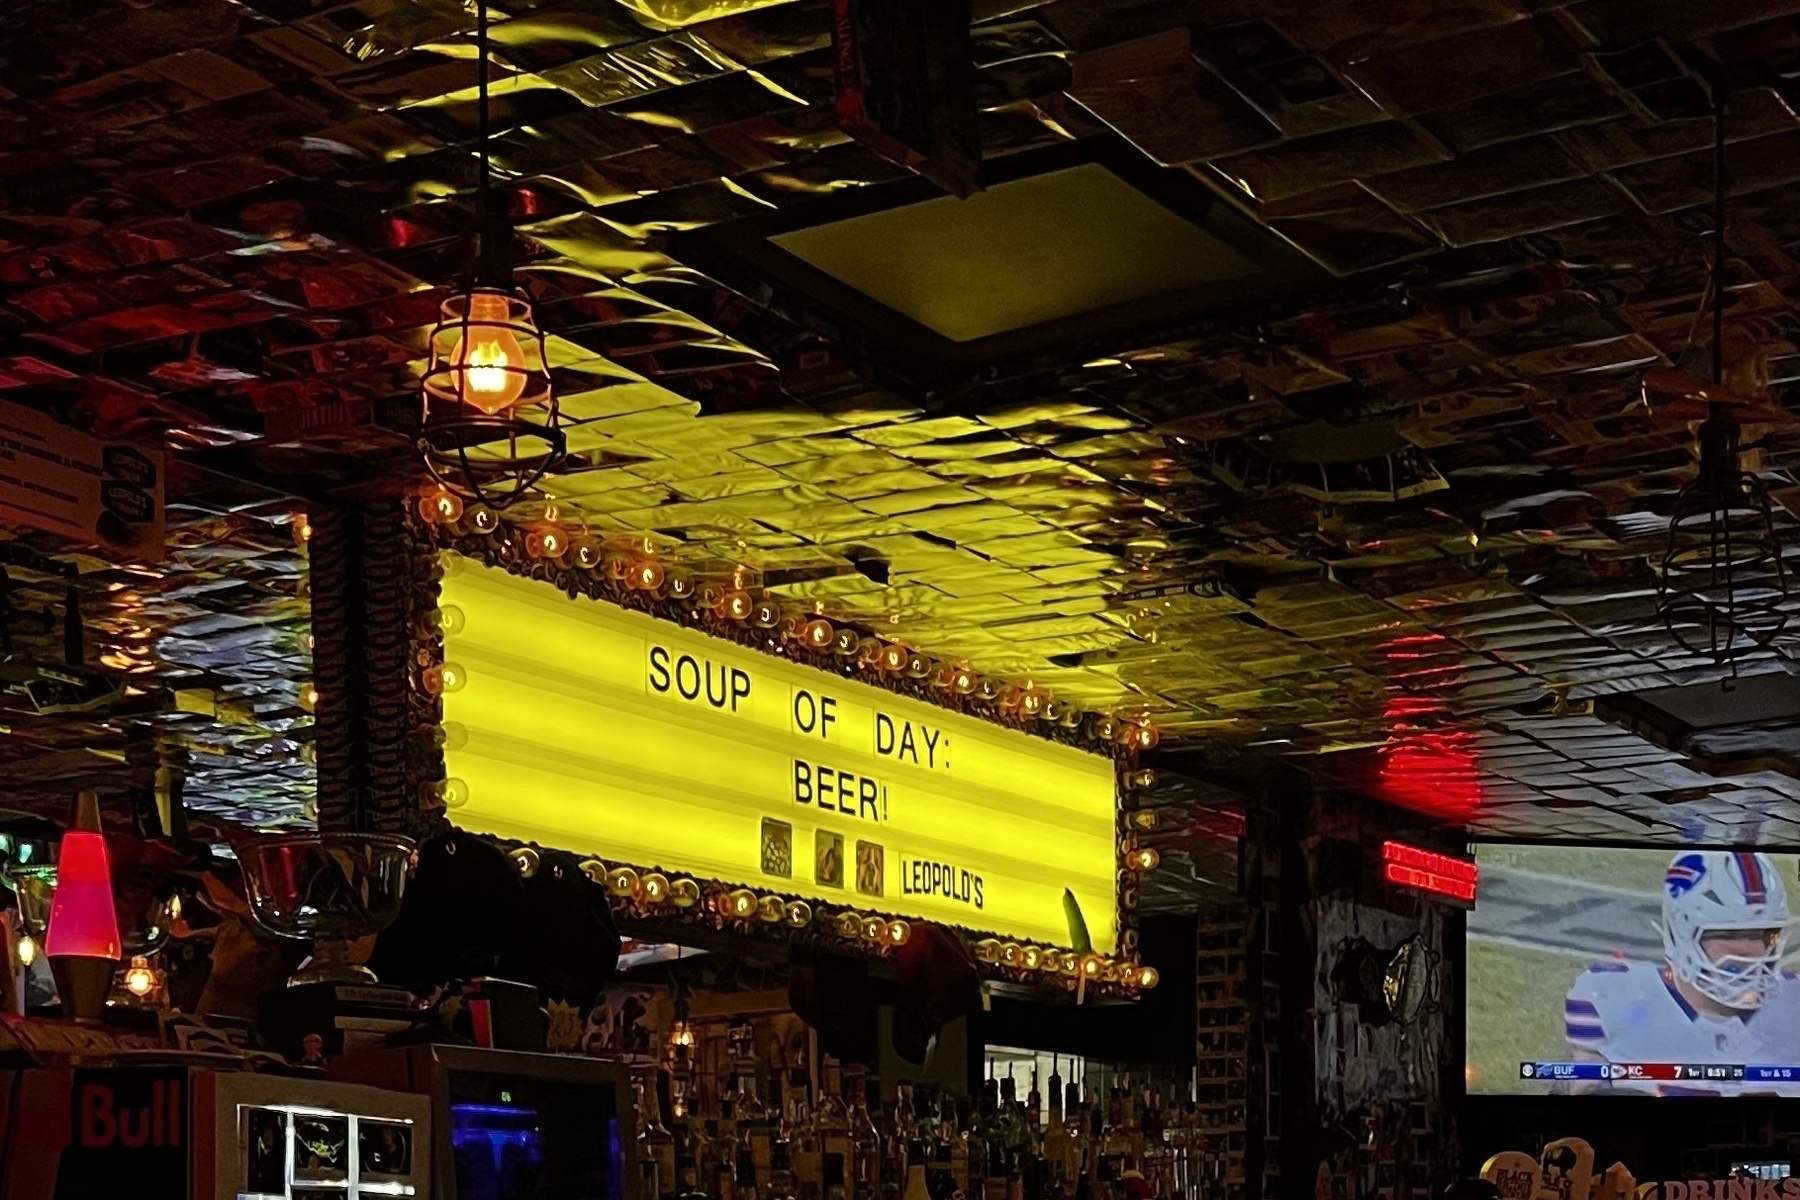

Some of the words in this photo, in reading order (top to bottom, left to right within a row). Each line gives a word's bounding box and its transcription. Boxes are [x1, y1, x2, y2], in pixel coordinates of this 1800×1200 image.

[648, 645, 752, 714] SOUP
[793, 690, 838, 739] OF
[875, 713, 952, 770] DAY:
[794, 758, 889, 822] BEER!
[902, 859, 985, 909] LEOPOLD'S
[1553, 1065, 1576, 1076] BUF
[1600, 1065, 1609, 1079] 0
[1628, 1065, 1644, 1076] KC
[1674, 1065, 1683, 1079] 7
[81, 1077, 181, 1149] Bull
